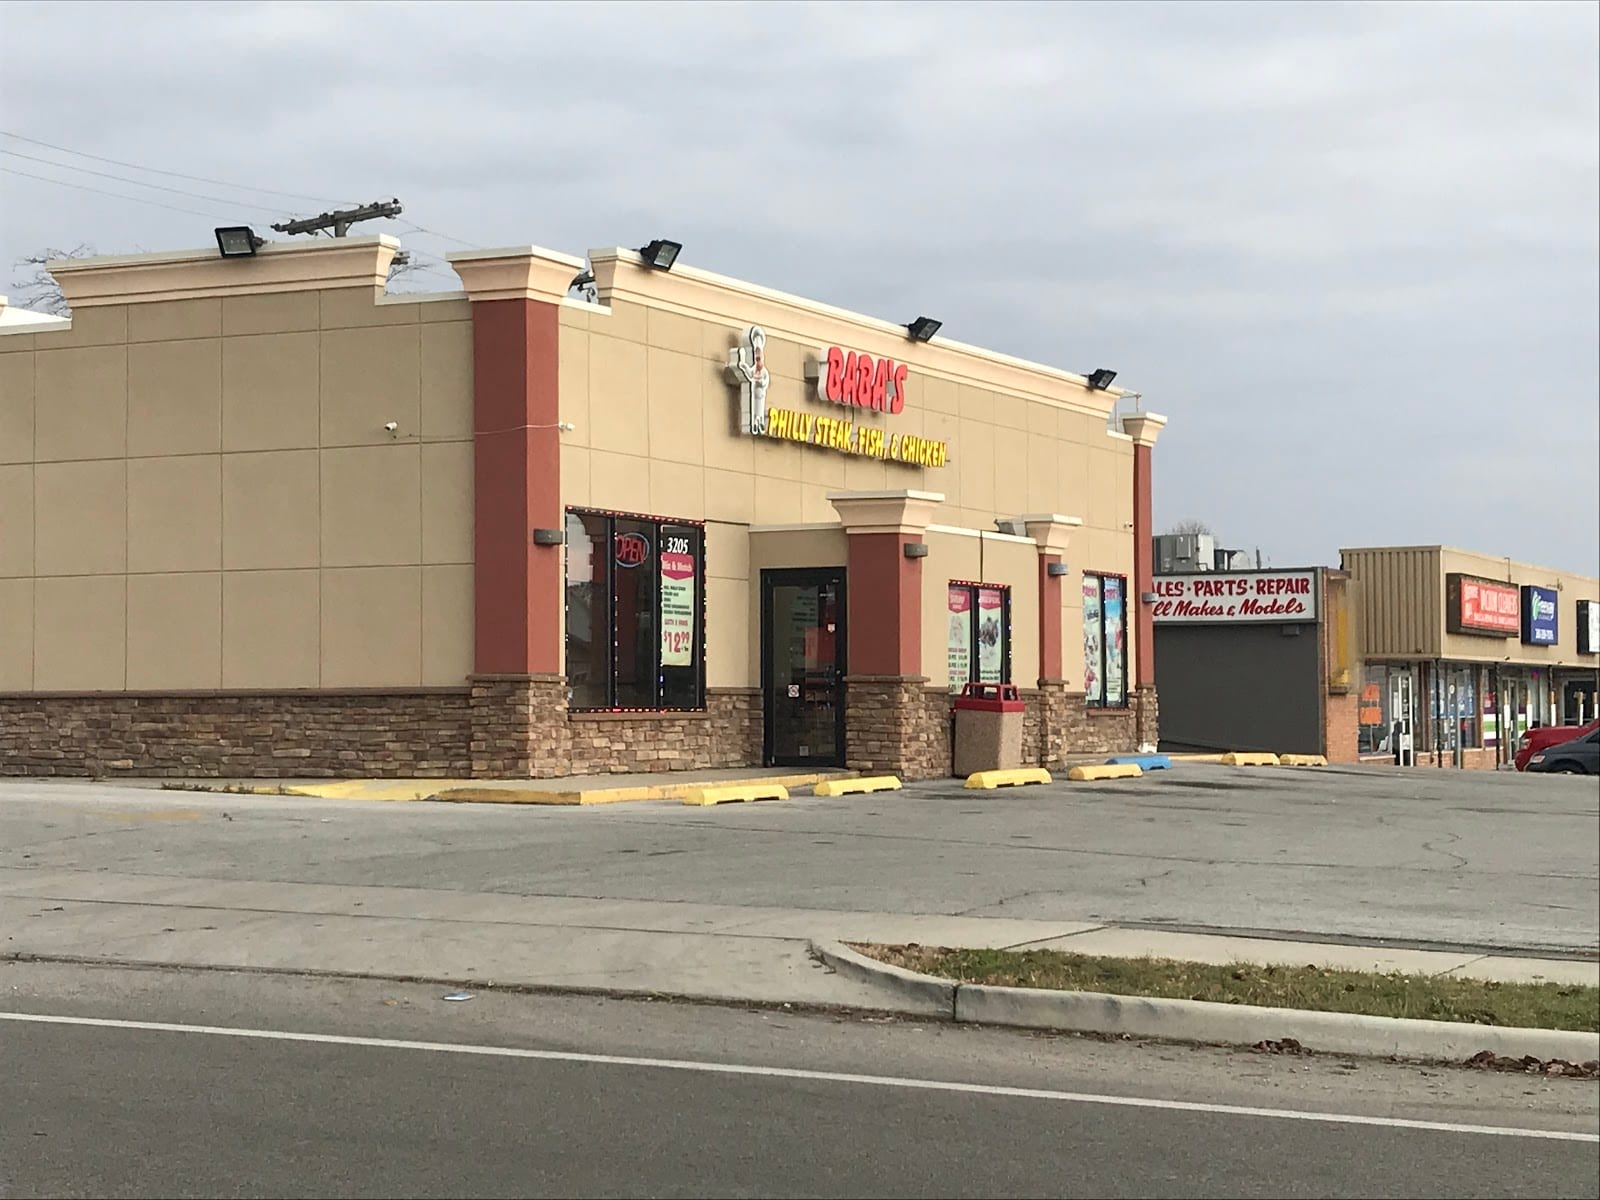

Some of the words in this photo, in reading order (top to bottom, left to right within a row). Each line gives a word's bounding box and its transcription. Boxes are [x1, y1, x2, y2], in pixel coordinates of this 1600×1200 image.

[826, 346, 908, 414] BABA'S
[768, 407, 813, 442] PHILLY
[814, 415, 855, 454] STEAK,
[858, 426, 887, 459] FISH,
[890, 433, 898, 459] &
[901, 435, 946, 467] CHICKEN
[615, 534, 645, 564] OPEN
[667, 537, 689, 555] 3205
[1152, 581, 1184, 597] LES
[1193, 580, 1248, 597] PARTS
[1256, 578, 1310, 595] REPAIR
[1152, 600, 1172, 617] ll
[1172, 599, 1224, 617] Makes
[1238, 597, 1306, 616] Models
